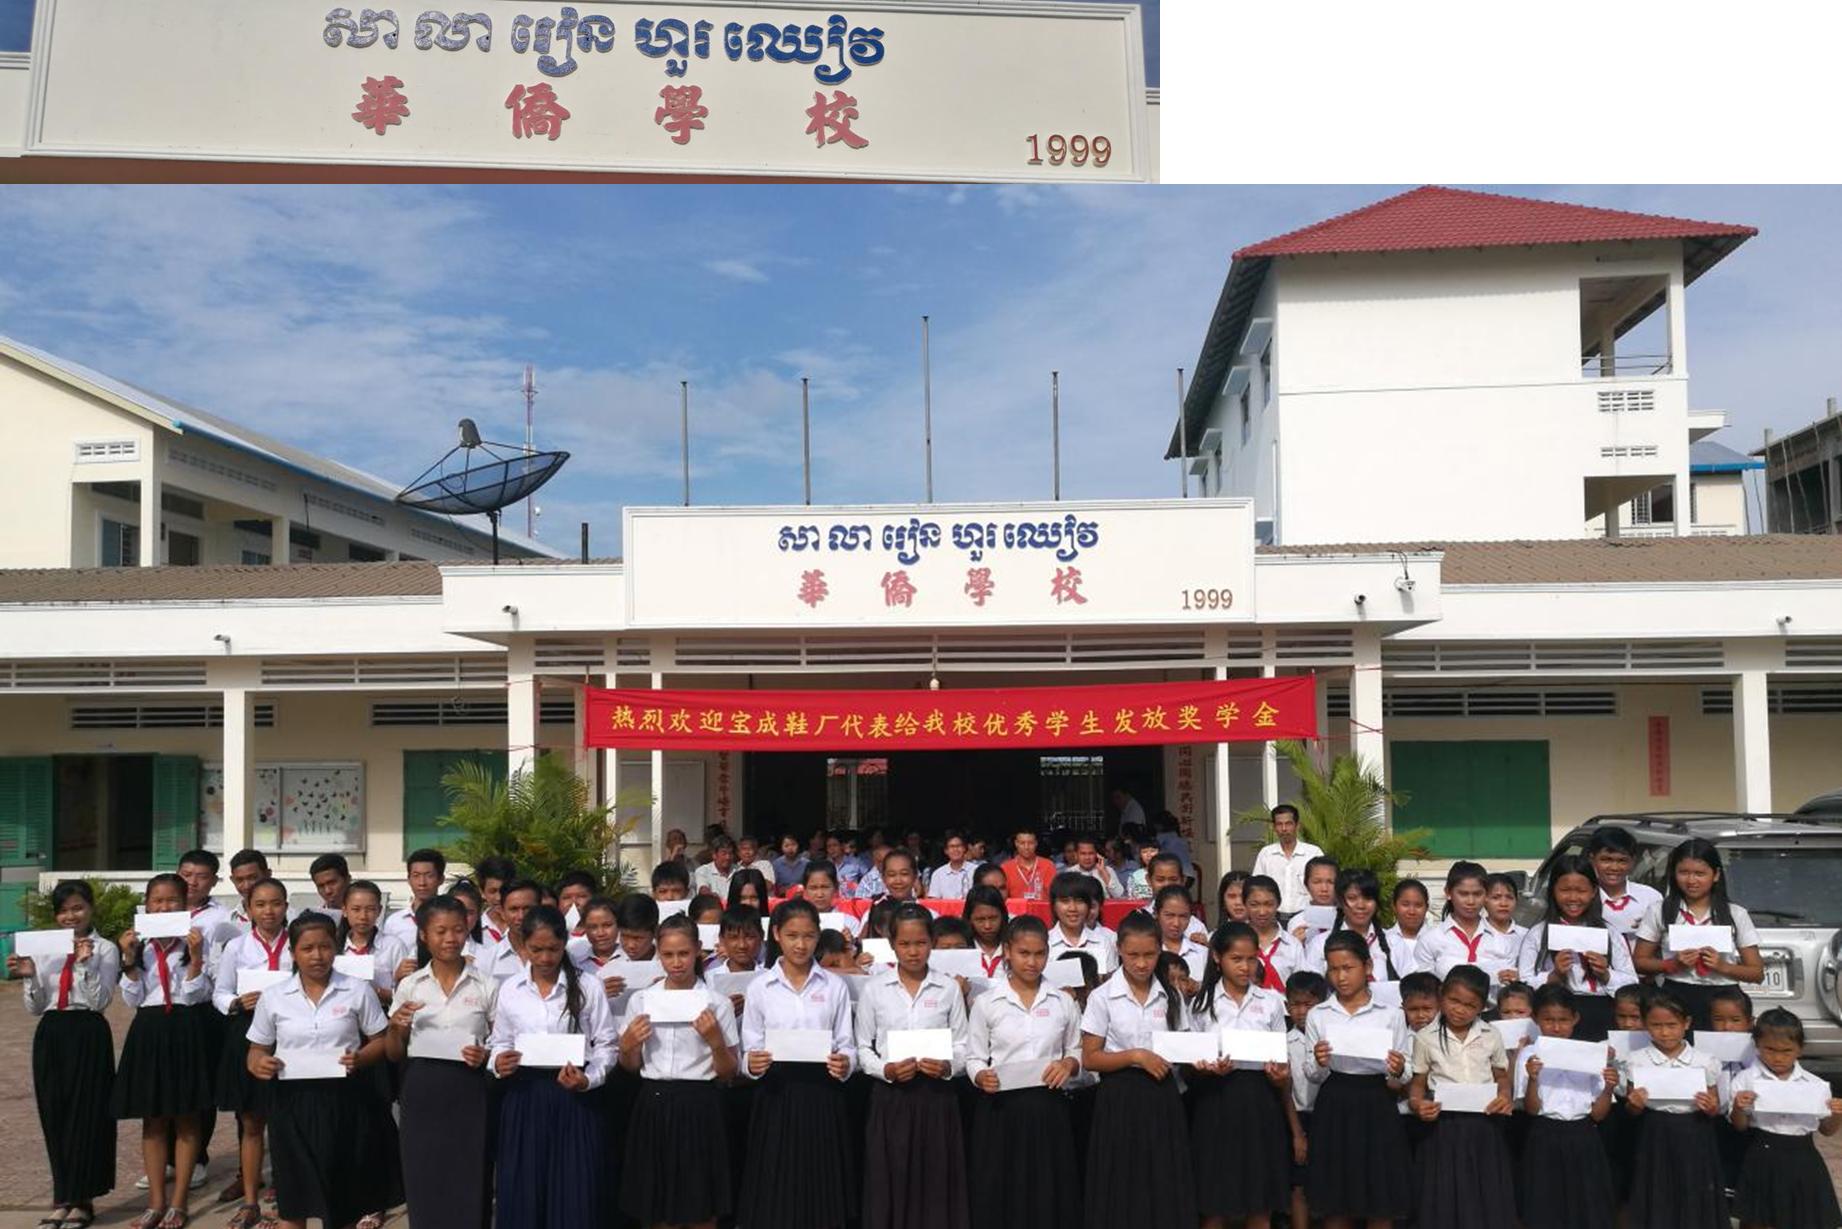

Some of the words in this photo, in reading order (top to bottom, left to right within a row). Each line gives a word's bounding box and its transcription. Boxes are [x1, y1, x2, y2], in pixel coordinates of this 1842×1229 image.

[1026, 134, 1112, 166] 1999
[1181, 588, 1233, 610] 1999
[611, 701, 1279, 738] 热烈欢迎宝成鞋厂代表给我校优秀学生发放奖学金
